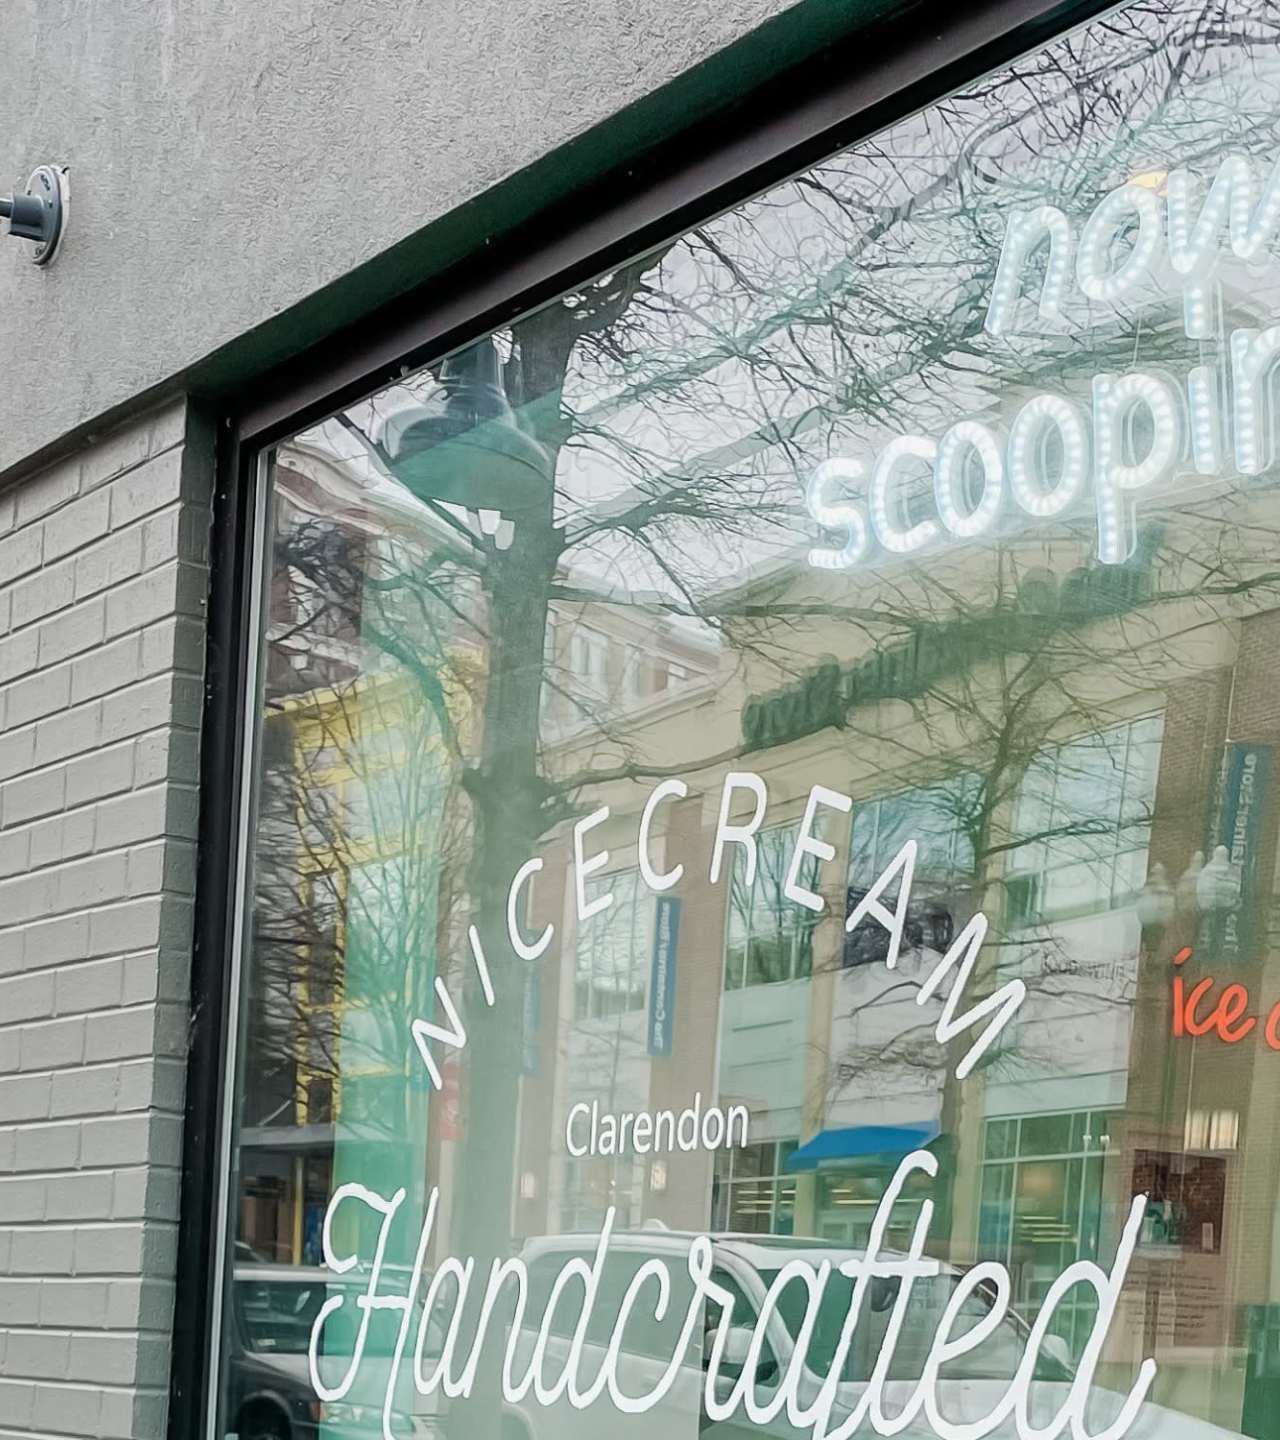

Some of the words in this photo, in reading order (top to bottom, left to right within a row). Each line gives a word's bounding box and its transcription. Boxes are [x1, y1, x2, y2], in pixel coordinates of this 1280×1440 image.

[411, 772, 1026, 1089] NICECREAM
[1173, 947, 1258, 1043] ice
[565, 1092, 750, 1159] Clarendon
